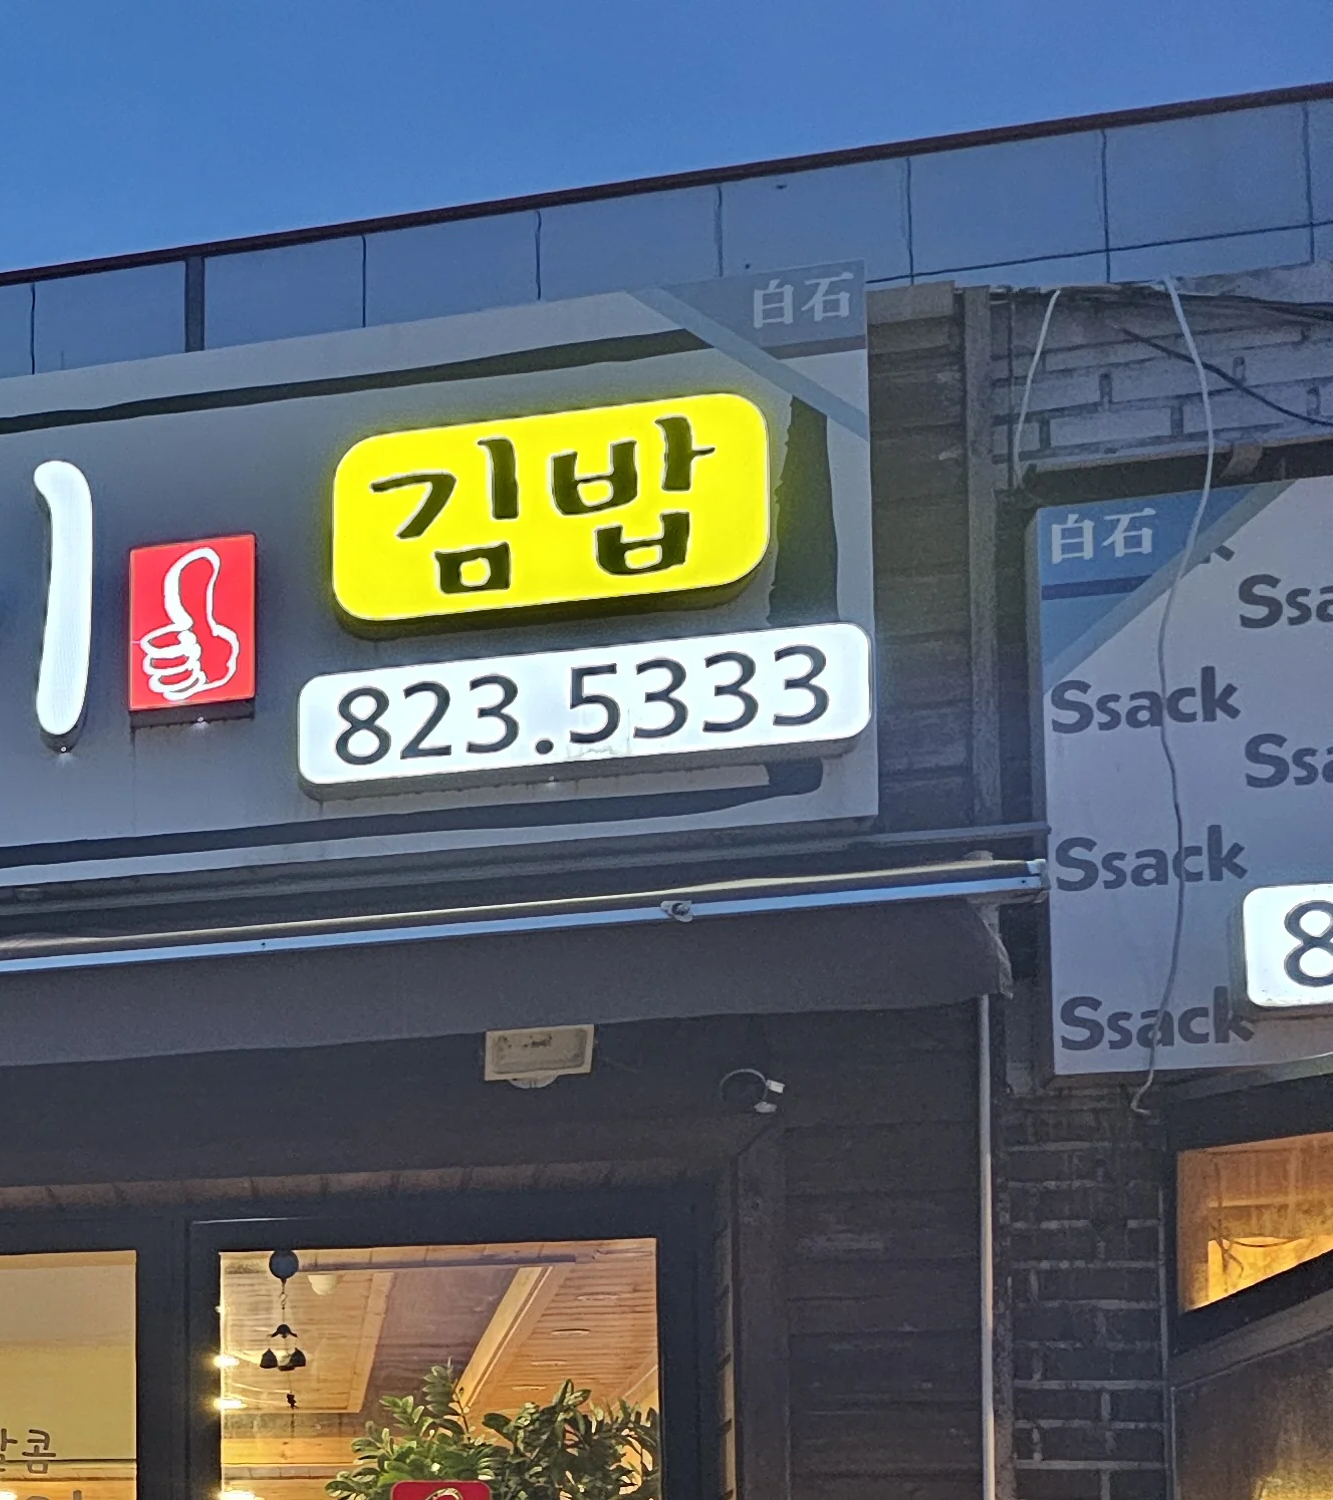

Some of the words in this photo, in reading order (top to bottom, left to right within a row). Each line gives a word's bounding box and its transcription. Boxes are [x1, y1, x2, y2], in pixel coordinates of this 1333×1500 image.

[751, 272, 853, 329] 白石
[369, 415, 717, 595] 김밥
[1050, 507, 1157, 564] 白石
[332, 644, 831, 766] 823.5333
[1050, 665, 1242, 734] Ssack
[1054, 824, 1249, 892] Ssack
[1283, 899, 1333, 988] 8
[1059, 985, 1255, 1051] Ssack
